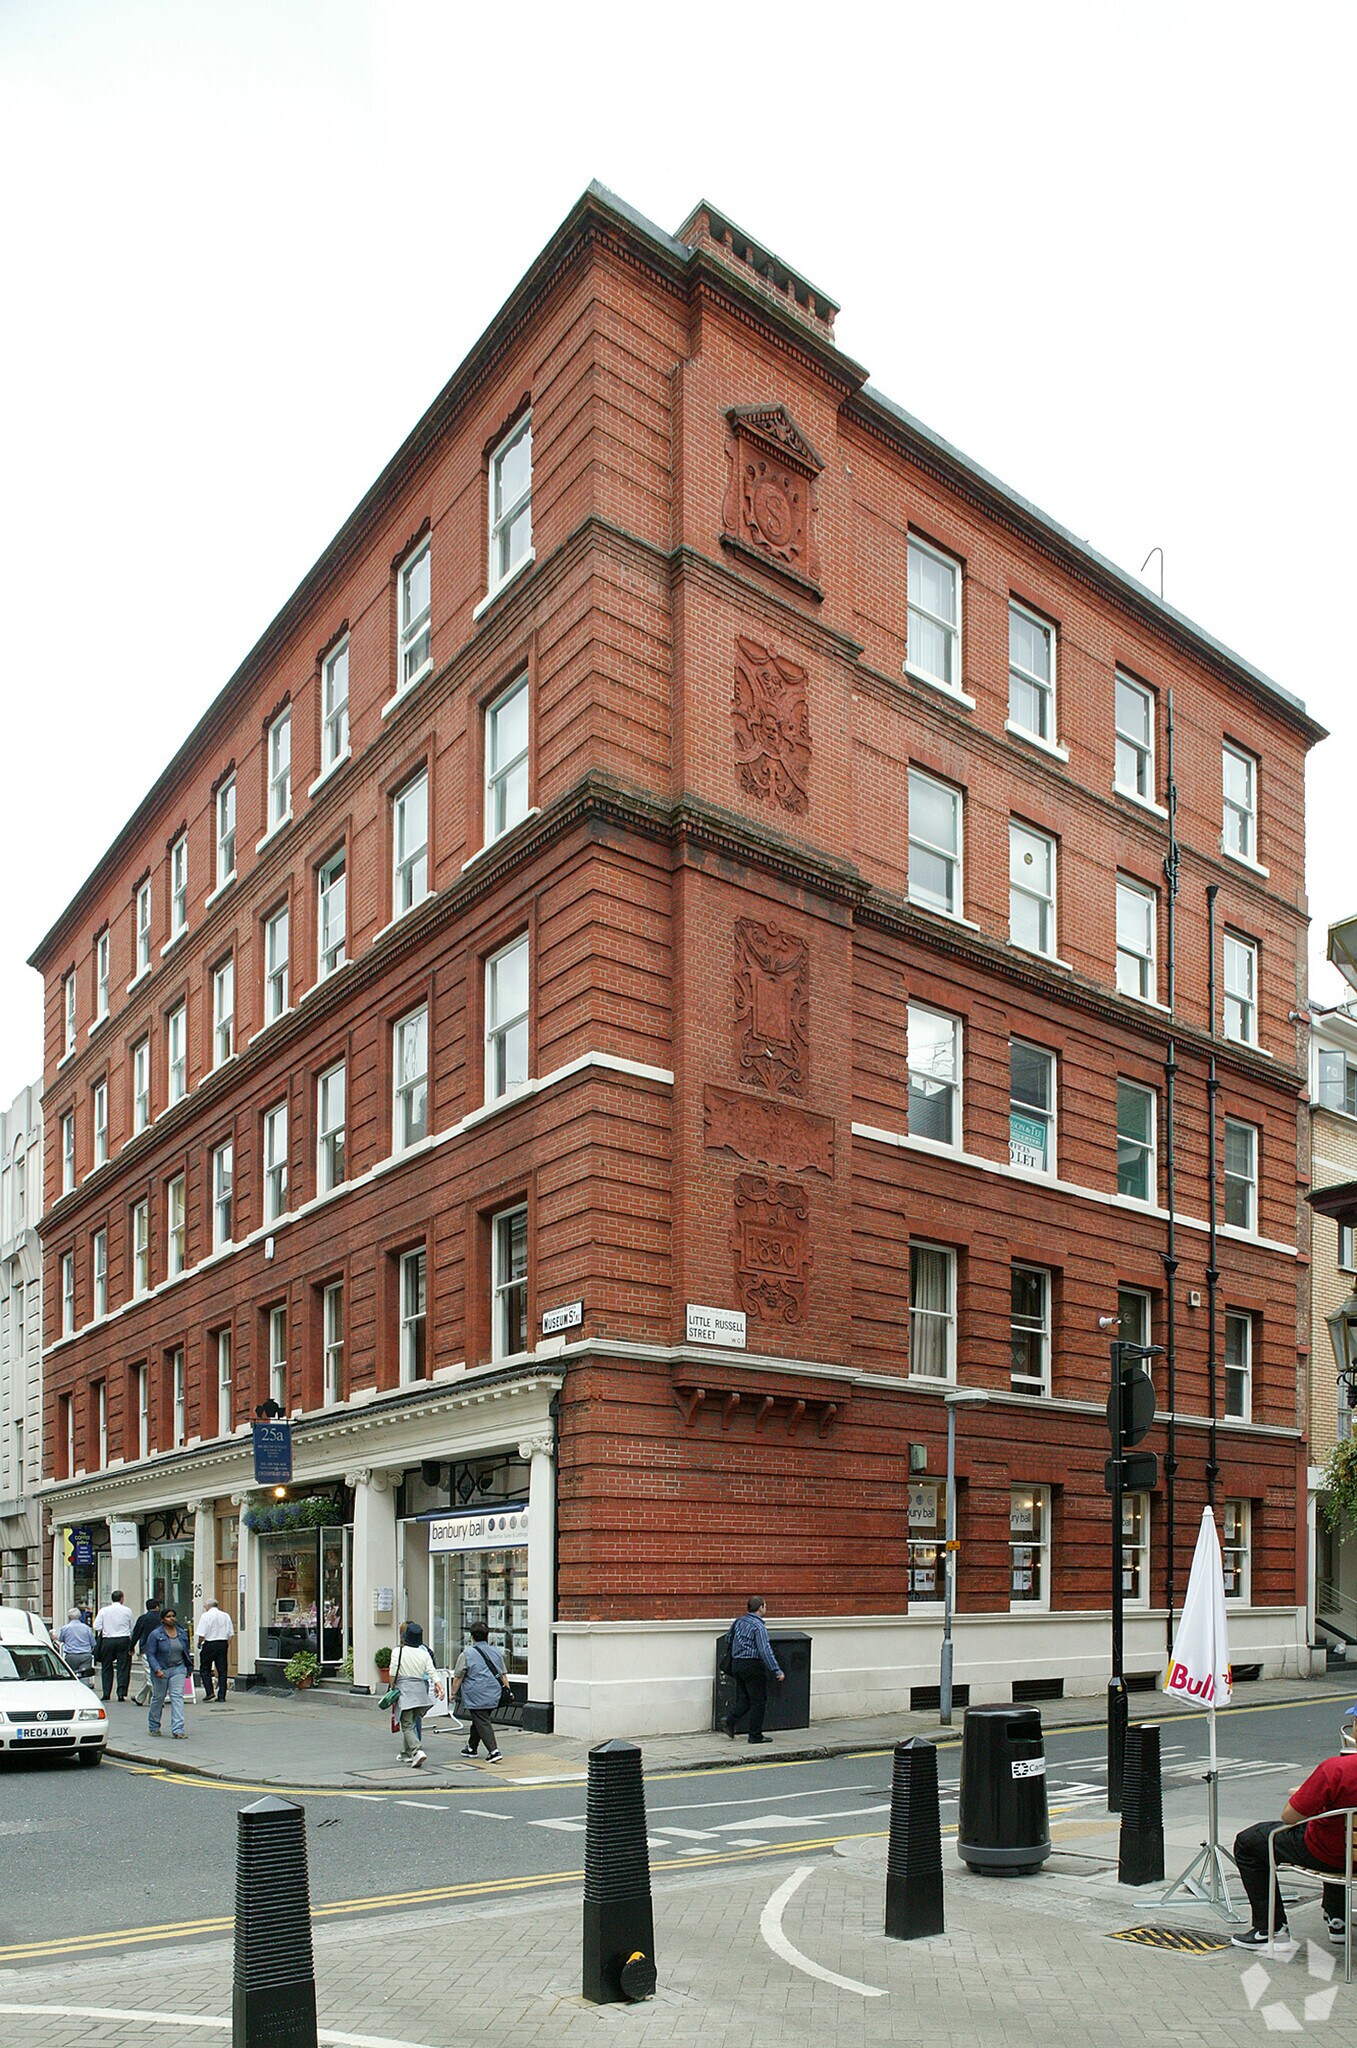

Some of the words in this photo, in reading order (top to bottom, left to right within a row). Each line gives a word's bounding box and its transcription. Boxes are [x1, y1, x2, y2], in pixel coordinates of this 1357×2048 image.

[1016, 1152, 1037, 1167] LET
[748, 1234, 796, 1269] 1890
[544, 1313, 568, 1331] MUSEUM
[689, 1315, 711, 1328] LITTLE
[715, 1319, 744, 1333] RUSSELL
[689, 1328, 716, 1340] STREET
[261, 1427, 284, 1442] 25a
[432, 1522, 468, 1541] banbury
[469, 1518, 485, 1537] ball
[195, 1584, 203, 1598] 25
[23, 1728, 48, 1738] RE04
[51, 1727, 69, 1736] AUX
